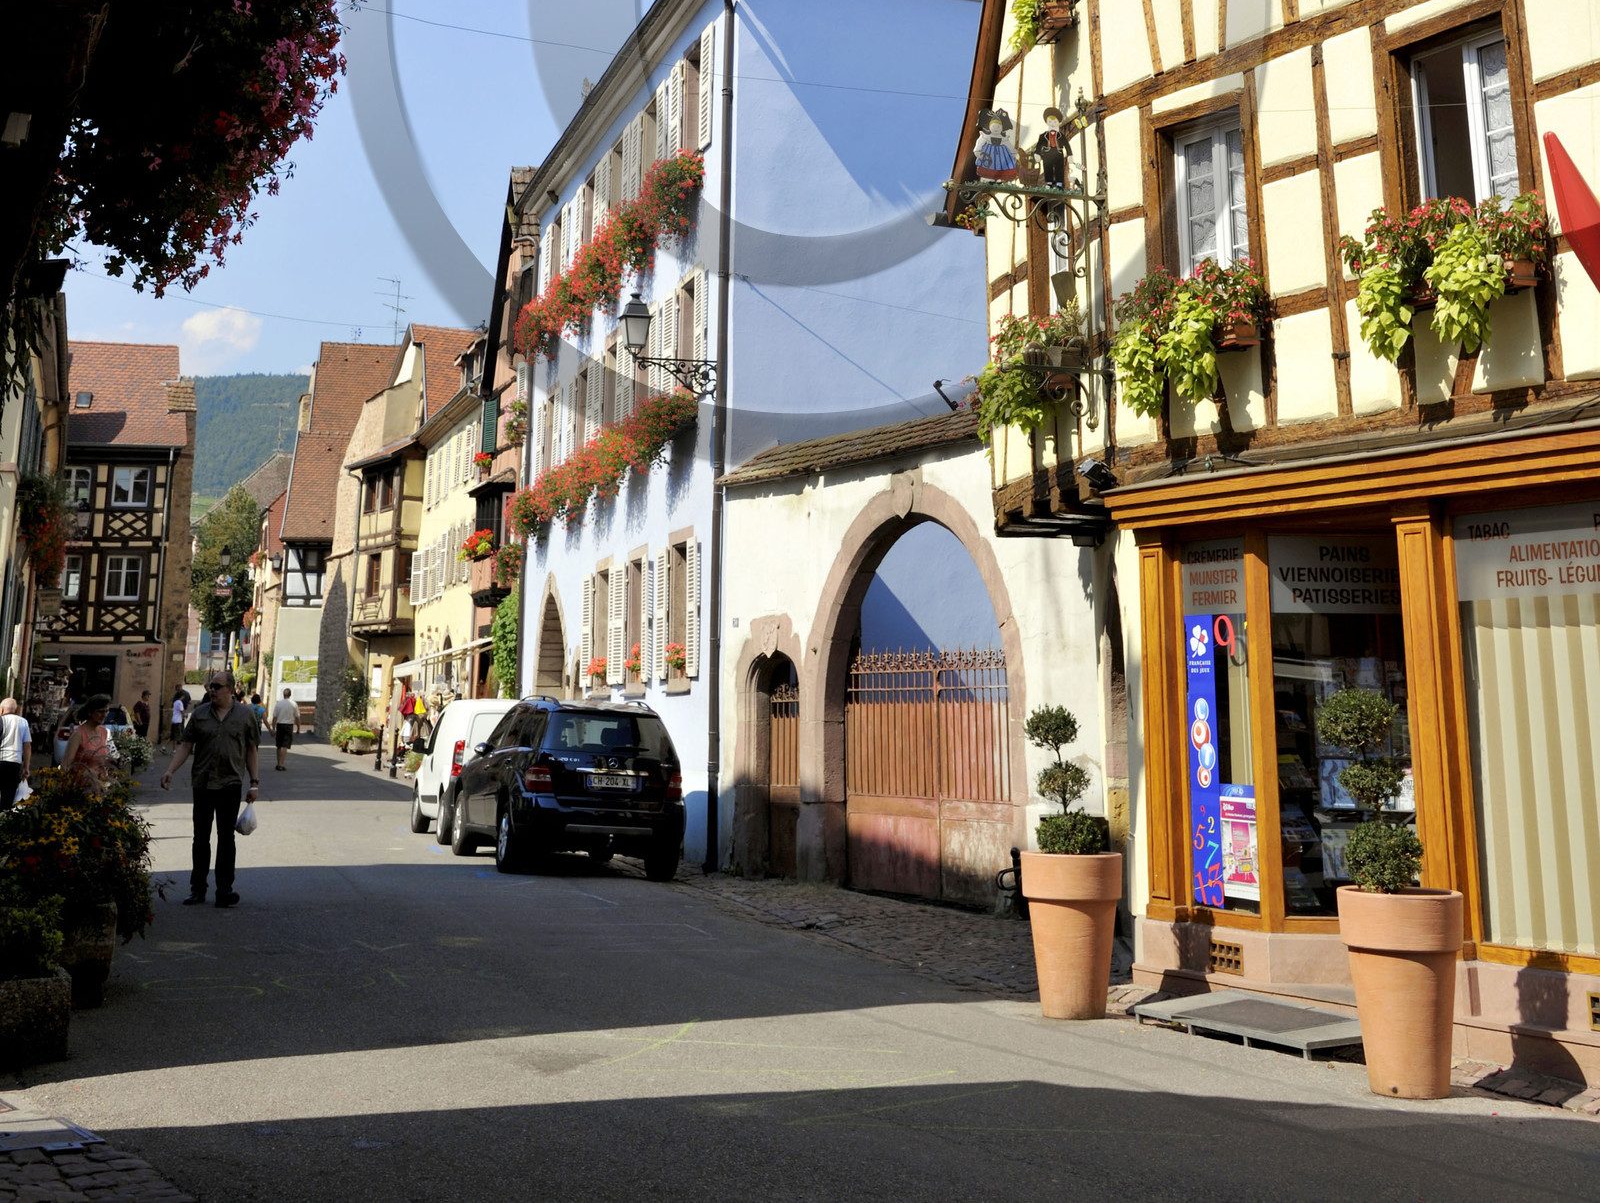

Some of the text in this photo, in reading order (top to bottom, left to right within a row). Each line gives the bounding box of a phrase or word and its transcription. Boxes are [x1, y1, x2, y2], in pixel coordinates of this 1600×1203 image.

[1467, 522, 1510, 542] TABAC
[1187, 546, 1239, 566] CRÈMERIE
[1319, 546, 1370, 562] PAINS
[1189, 568, 1238, 586] MUNSTER
[1192, 589, 1237, 606] FERMIER
[1292, 588, 1402, 605] PATISSERIES
